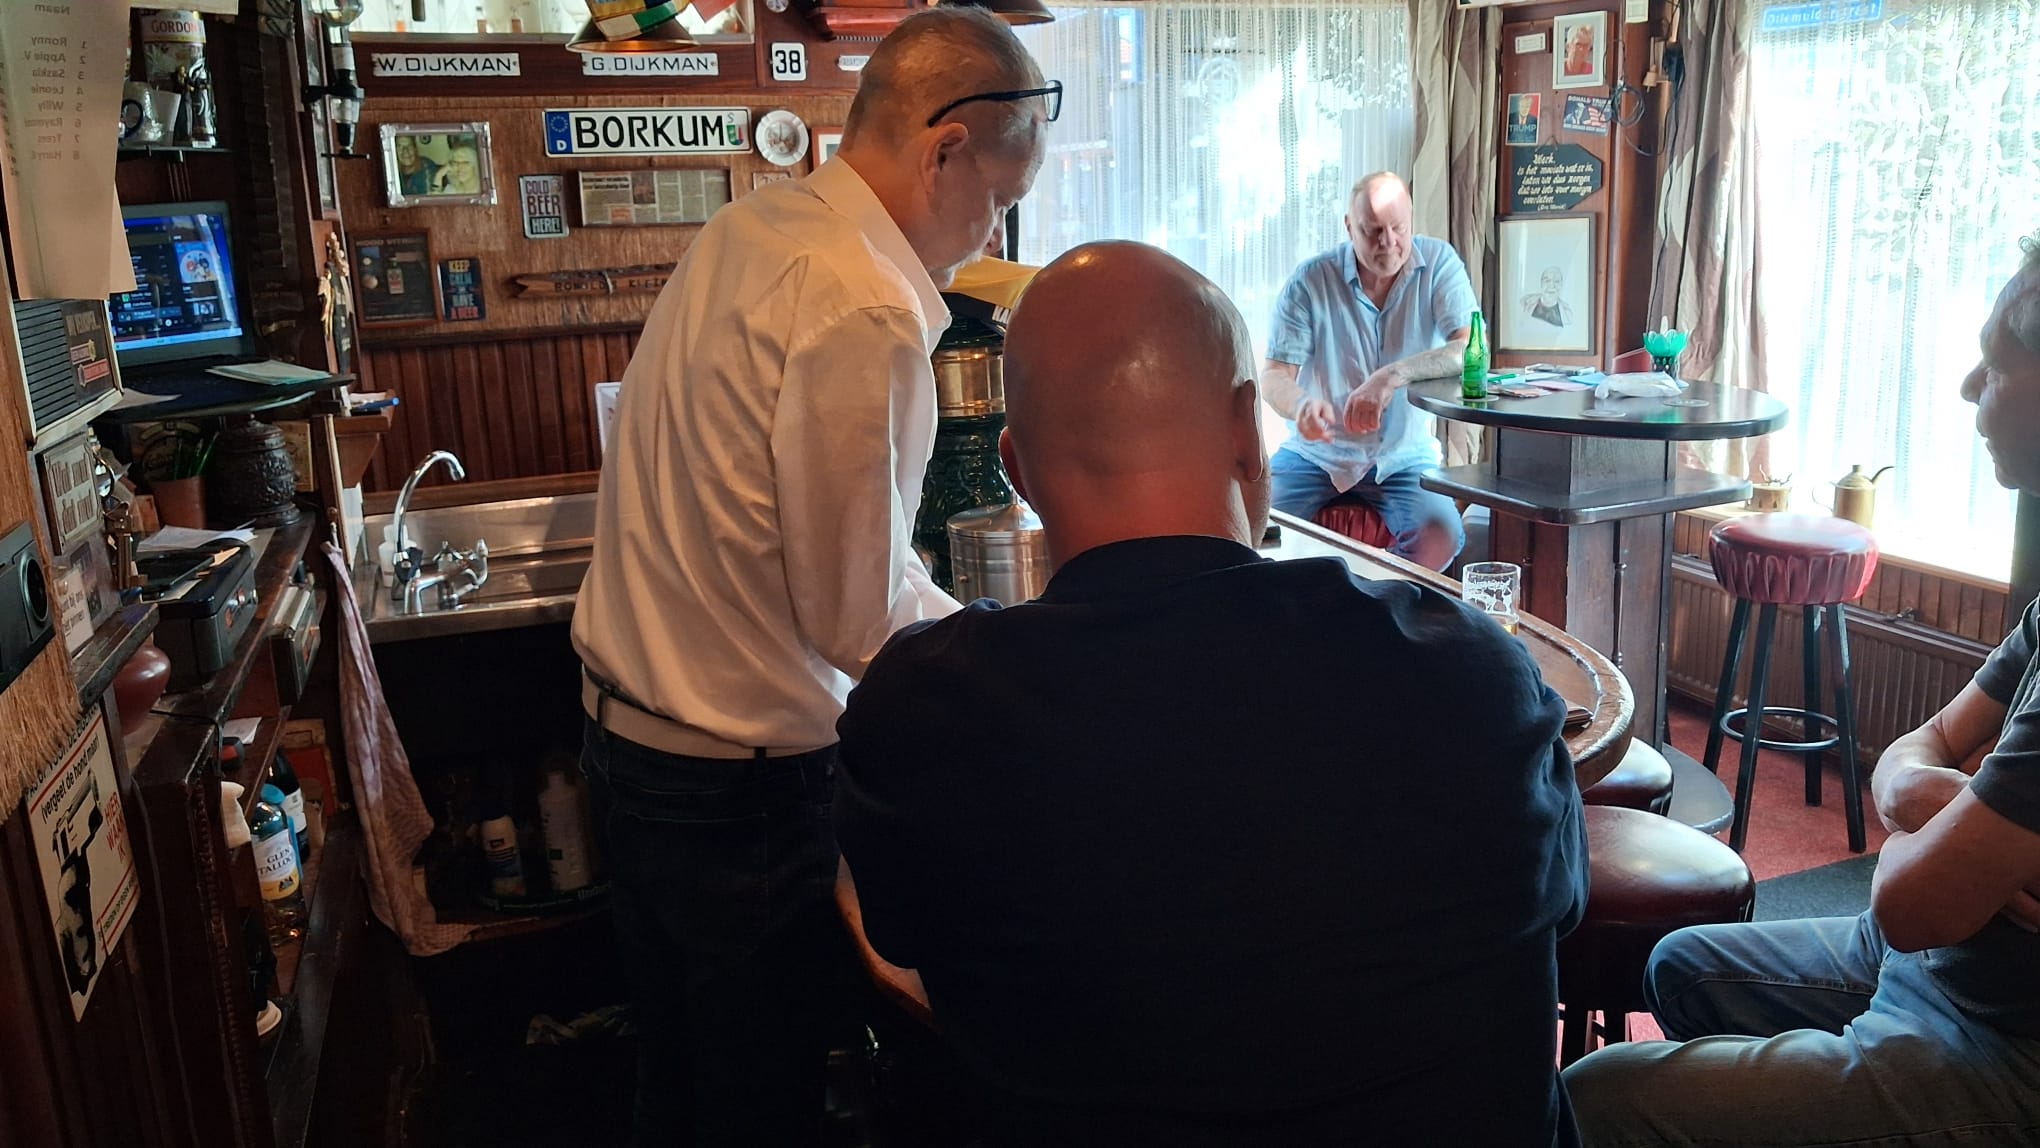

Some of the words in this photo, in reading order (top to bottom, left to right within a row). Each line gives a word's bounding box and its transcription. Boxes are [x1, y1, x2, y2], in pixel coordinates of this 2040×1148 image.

[774, 49, 802, 74] 38
[574, 114, 725, 149] BORKUM
[1509, 123, 1537, 133] TRUMP
[556, 139, 567, 151] D
[525, 180, 550, 195] COLD
[527, 194, 561, 216] BEER
[531, 217, 561, 233] HERE!
[64, 767, 74, 790] de
[266, 848, 290, 864] GLEN
